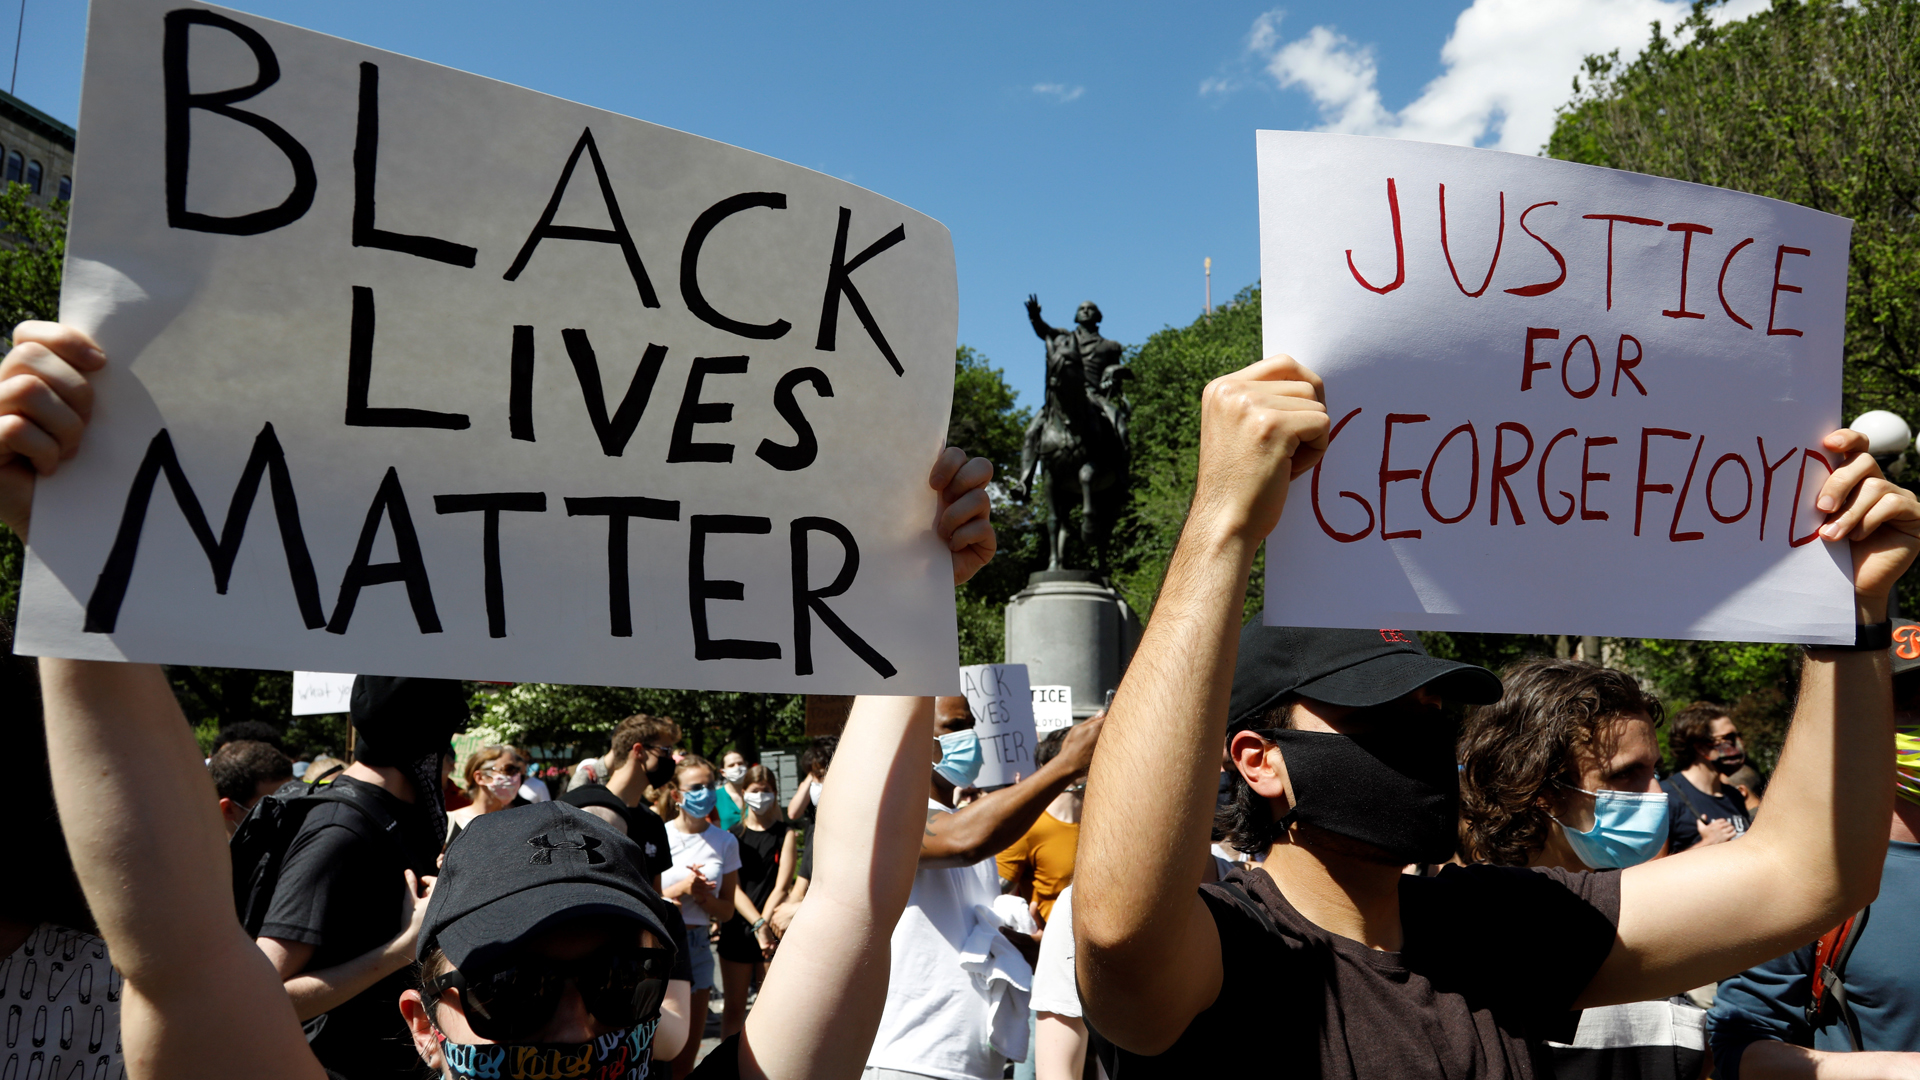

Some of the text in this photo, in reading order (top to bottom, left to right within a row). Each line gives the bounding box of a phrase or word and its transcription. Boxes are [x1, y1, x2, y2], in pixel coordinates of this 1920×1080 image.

[163, 8, 906, 378] BLACK
[1346, 177, 1811, 337] JUSTICE
[344, 285, 835, 472] LIVES
[1521, 327, 1647, 399] FOR
[84, 421, 898, 680] MATTER
[1311, 408, 1834, 548] GEORGE FLOYD
[337, 684, 352, 704] yo
